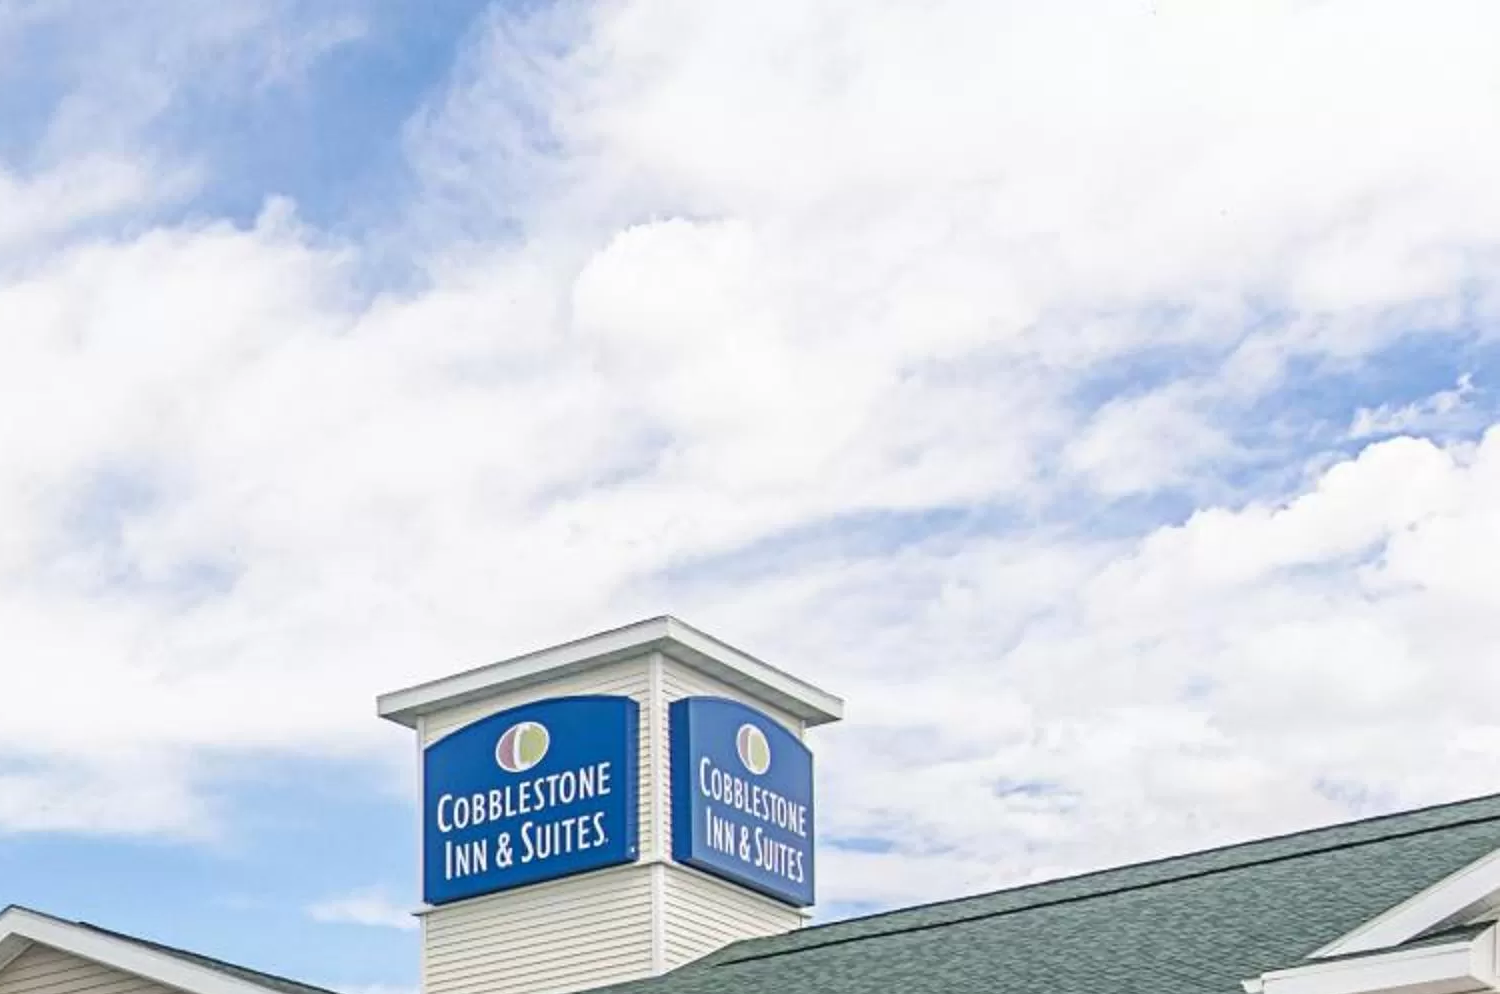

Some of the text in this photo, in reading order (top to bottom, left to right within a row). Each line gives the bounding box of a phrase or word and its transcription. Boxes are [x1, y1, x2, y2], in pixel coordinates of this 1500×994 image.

[437, 762, 611, 833] COBBLESTONE
[699, 756, 807, 838] COBBLESTONE
[445, 812, 605, 880] INN & SUITES
[706, 805, 805, 883] INN & SUITES
